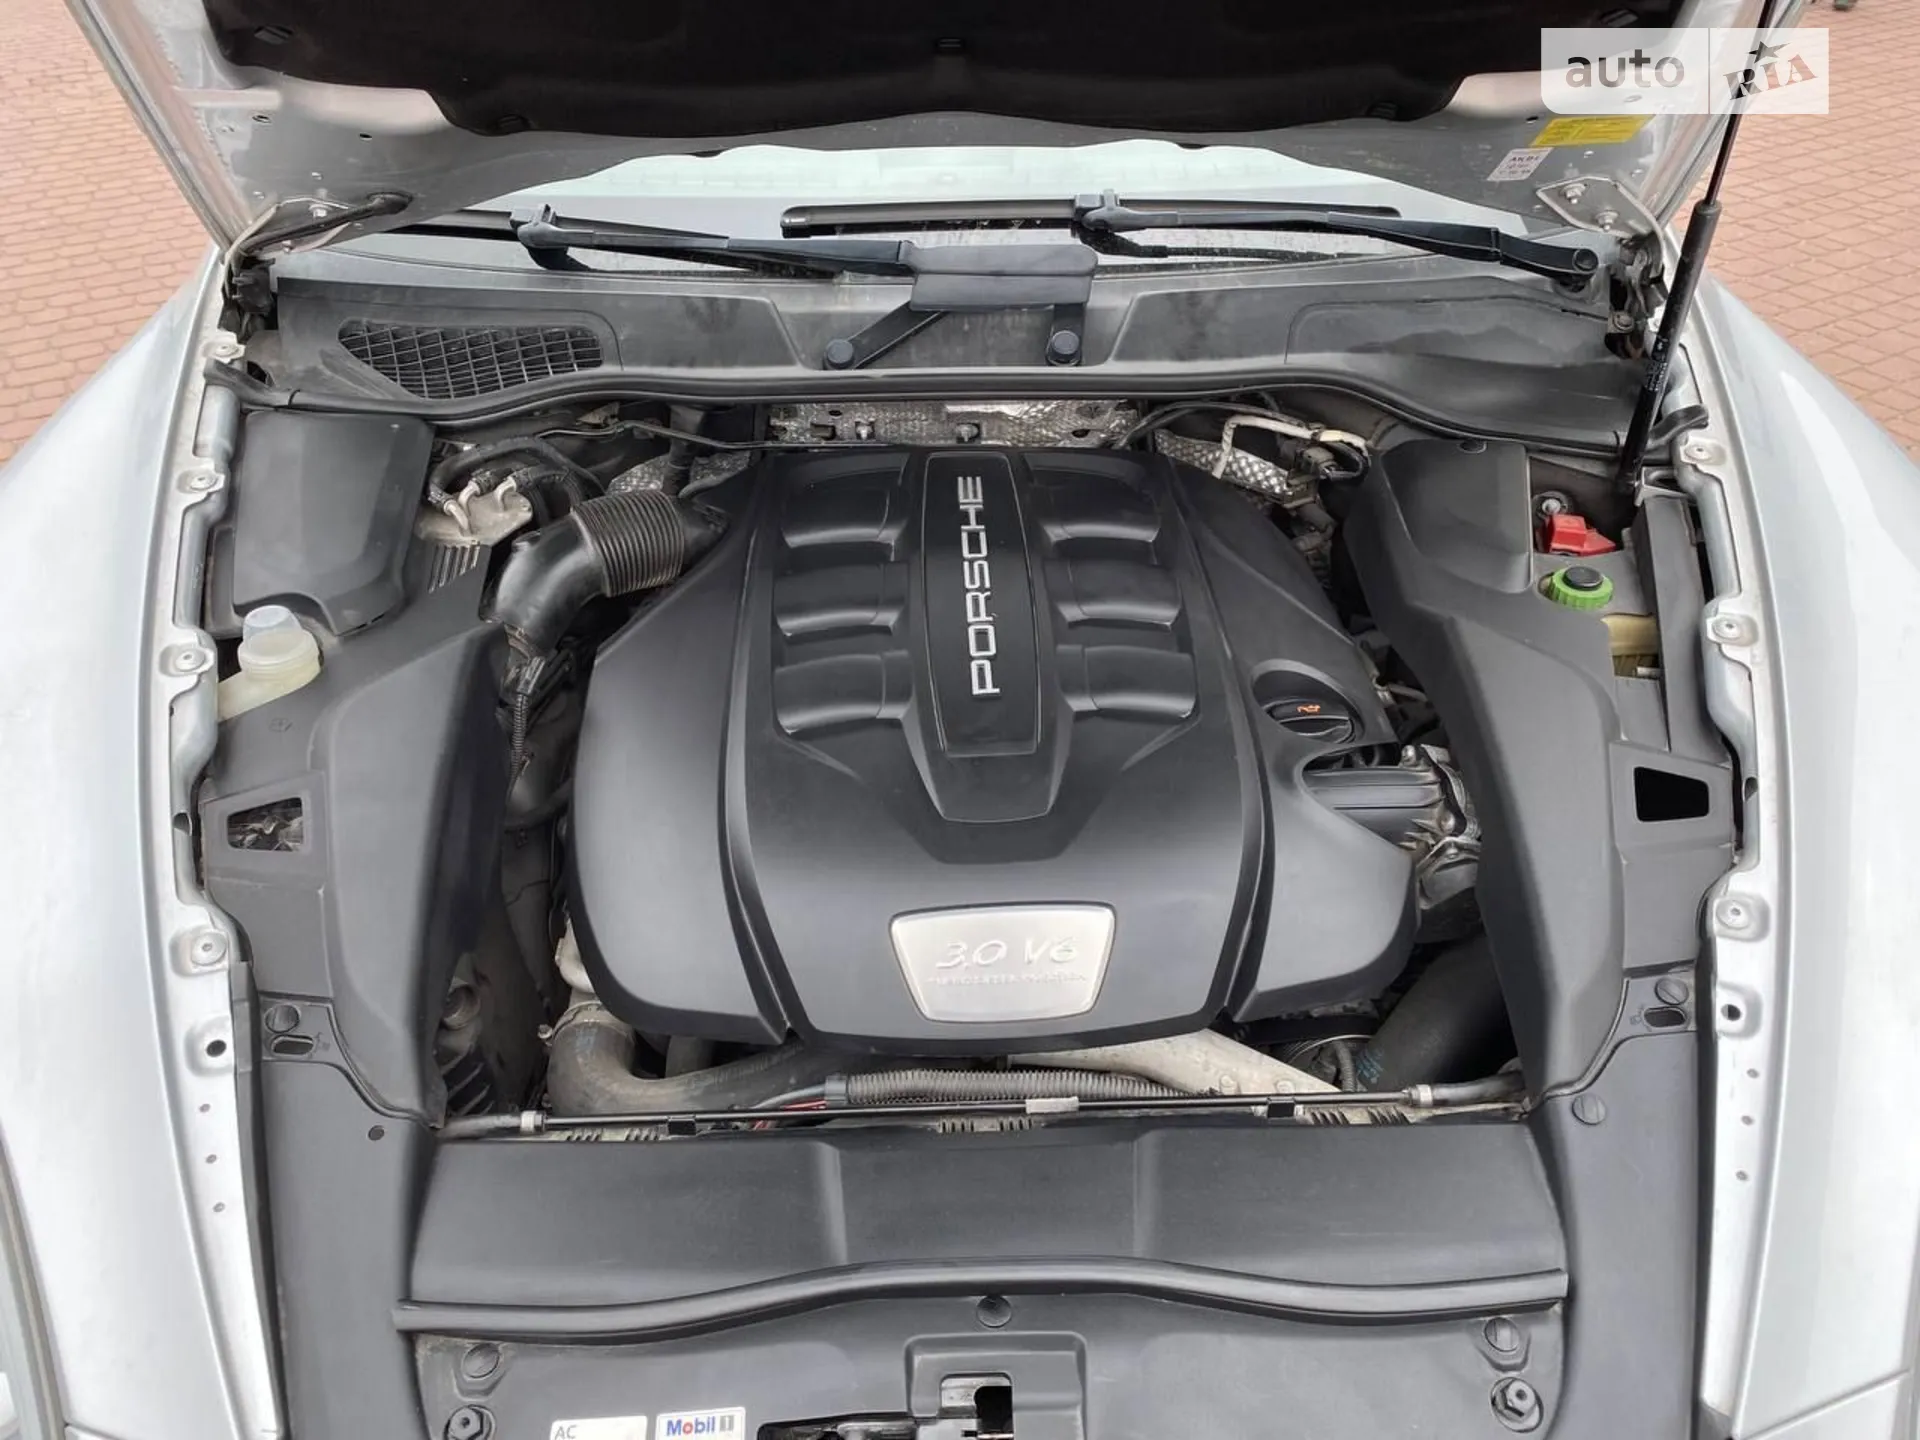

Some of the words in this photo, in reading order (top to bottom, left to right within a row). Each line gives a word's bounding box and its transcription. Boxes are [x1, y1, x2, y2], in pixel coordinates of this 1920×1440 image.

[957, 476, 1000, 695] PORSCHE
[1024, 936, 1078, 965] V6
[554, 1425, 578, 1440] AC
[666, 1416, 716, 1436] Mobil
